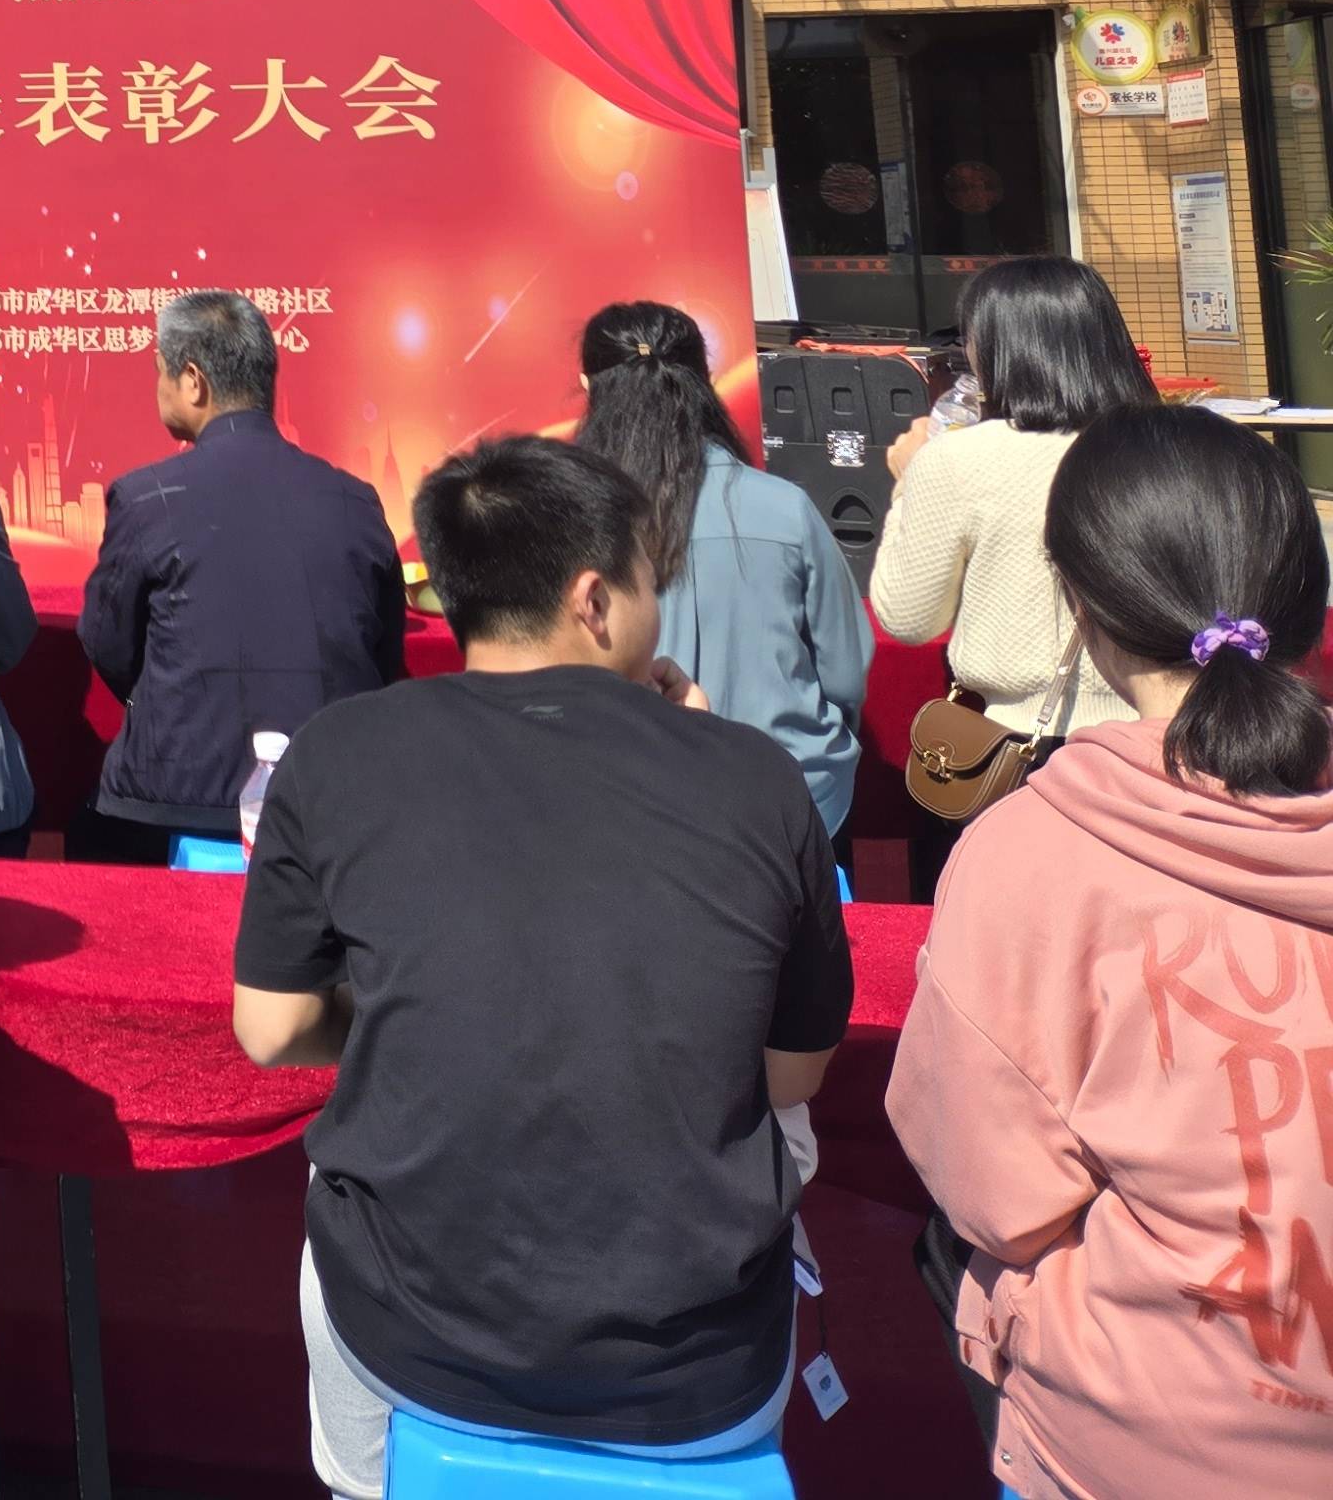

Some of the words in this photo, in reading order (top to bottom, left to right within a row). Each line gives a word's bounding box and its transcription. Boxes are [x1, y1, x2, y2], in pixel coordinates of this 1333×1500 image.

[1095, 57, 1138, 66] 儿童之家
[1110, 92, 1157, 102] 家长学校
